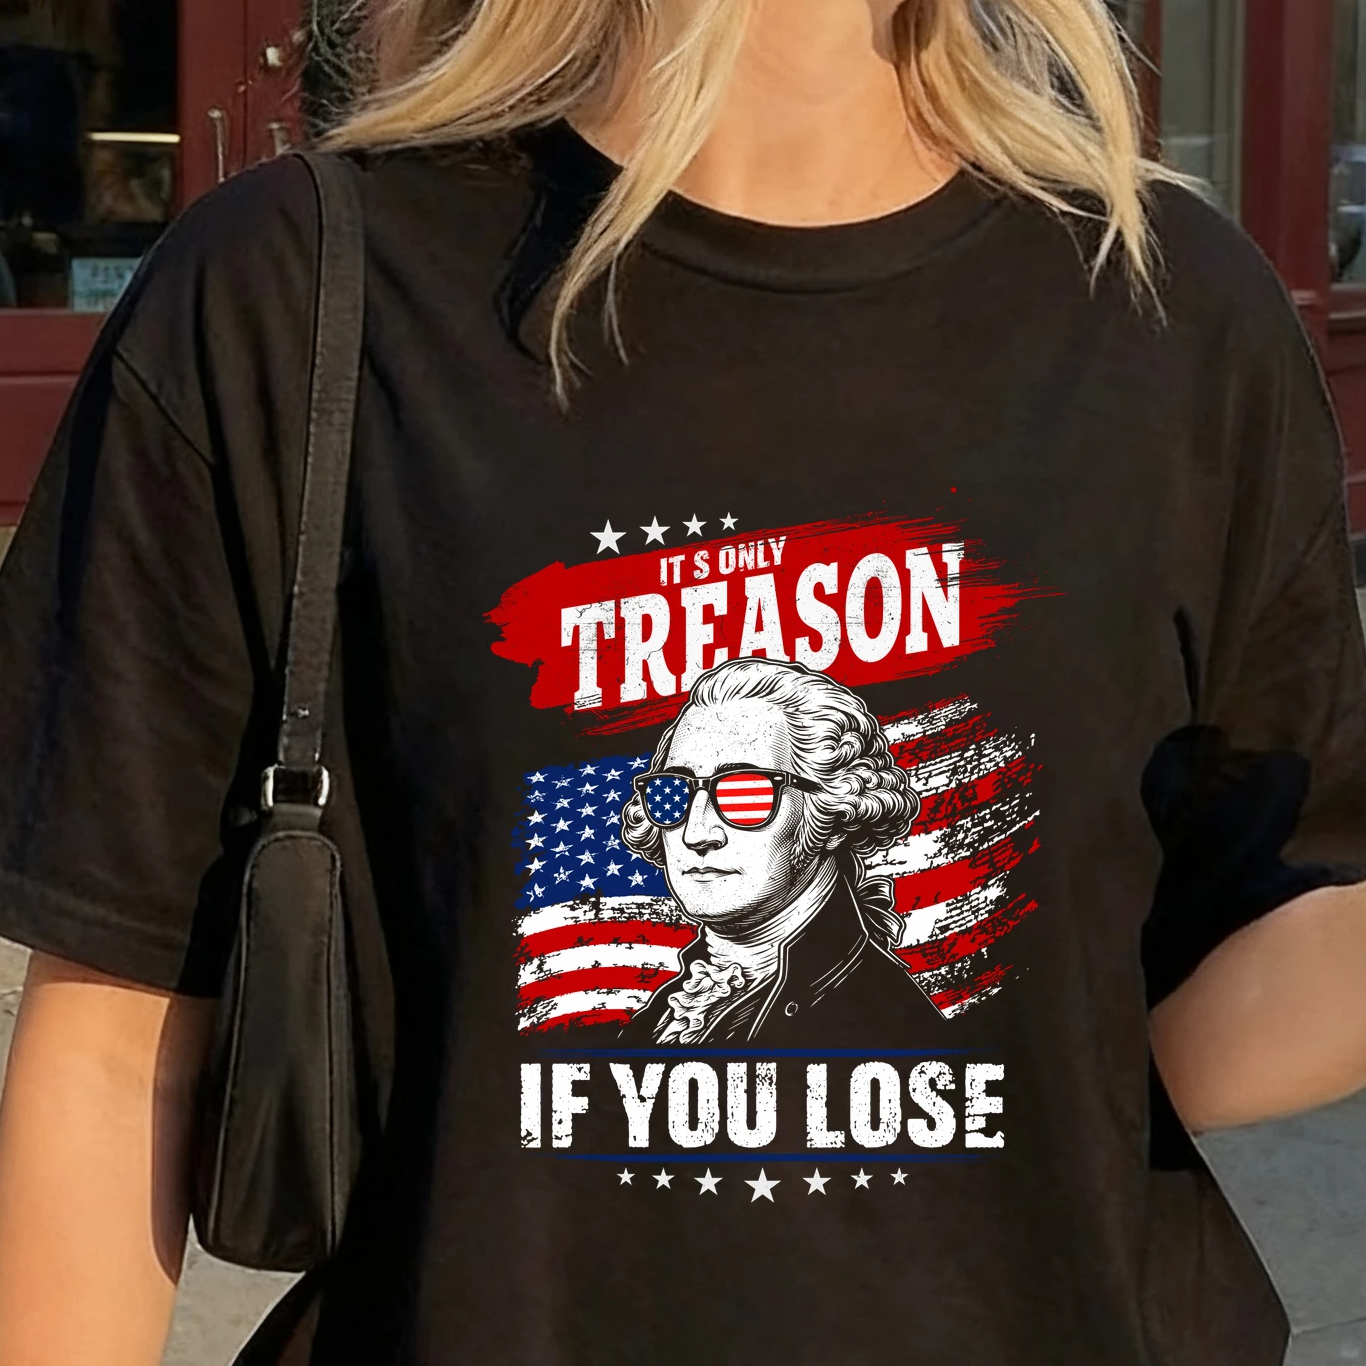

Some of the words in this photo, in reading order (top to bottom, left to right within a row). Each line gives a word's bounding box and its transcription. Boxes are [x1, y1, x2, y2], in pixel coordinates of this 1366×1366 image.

[718, 536, 787, 575] ONLY
[561, 541, 965, 711] TREASON
[520, 1063, 591, 1149] IF
[609, 1061, 778, 1149] YOU
[806, 1060, 1005, 1149] LOSE
